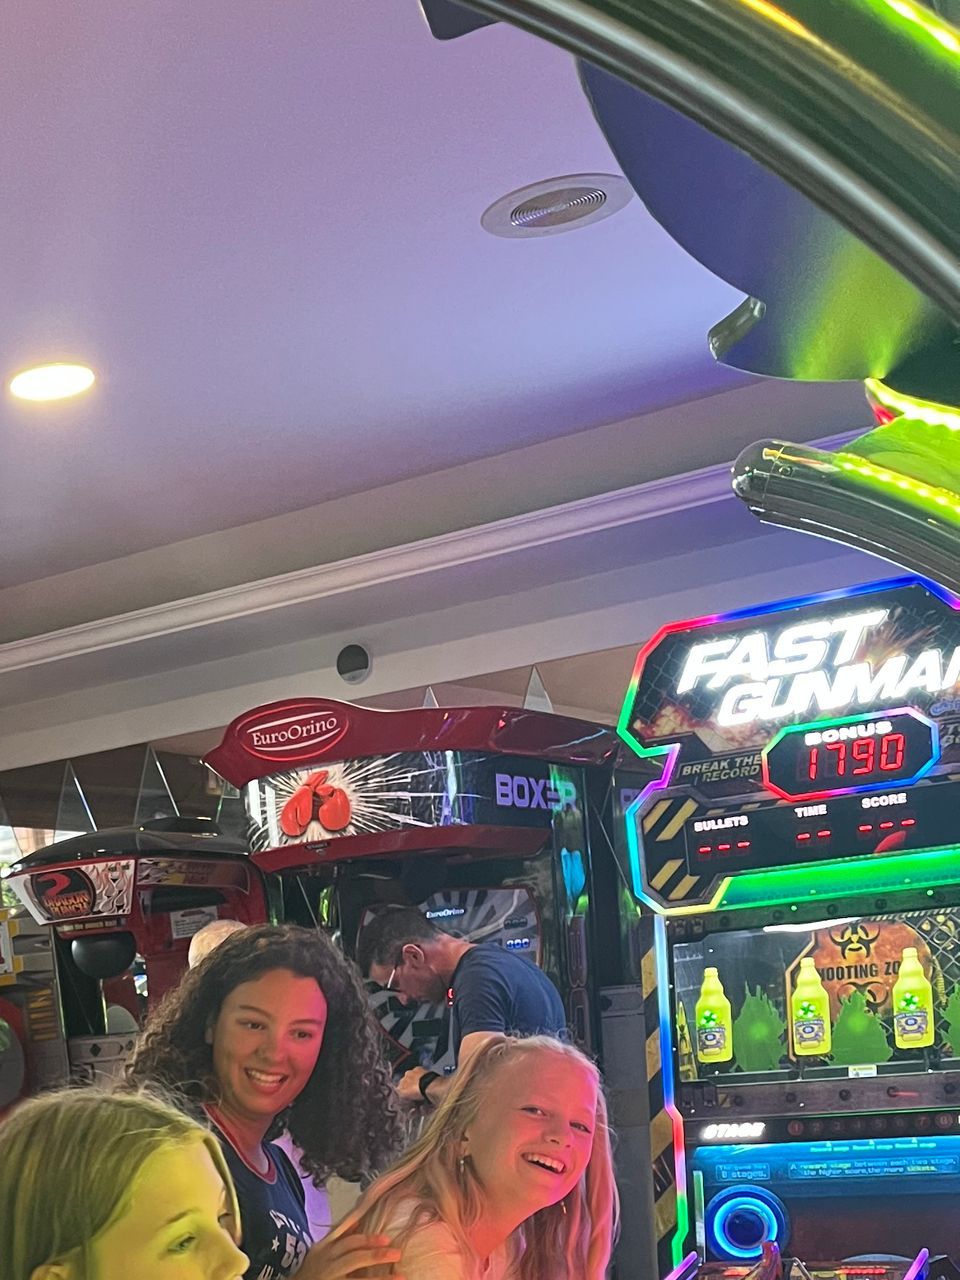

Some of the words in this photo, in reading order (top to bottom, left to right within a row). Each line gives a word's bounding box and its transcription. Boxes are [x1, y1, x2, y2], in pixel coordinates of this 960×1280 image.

[676, 608, 890, 695] FAST
[252, 716, 338, 747] EuroOrino
[804, 720, 893, 746] BONUS
[682, 759, 730, 776] BREAK
[734, 754, 762, 766] THE
[808, 733, 906, 780] 1790
[702, 765, 760, 782] RECORD
[495, 773, 577, 812] BOXER
[694, 815, 749, 832] BULLETS
[795, 804, 827, 818] TIME
[861, 792, 907, 809] SCORE
[816, 963, 878, 982] HOOTING
[884, 960, 901, 976] ZO
